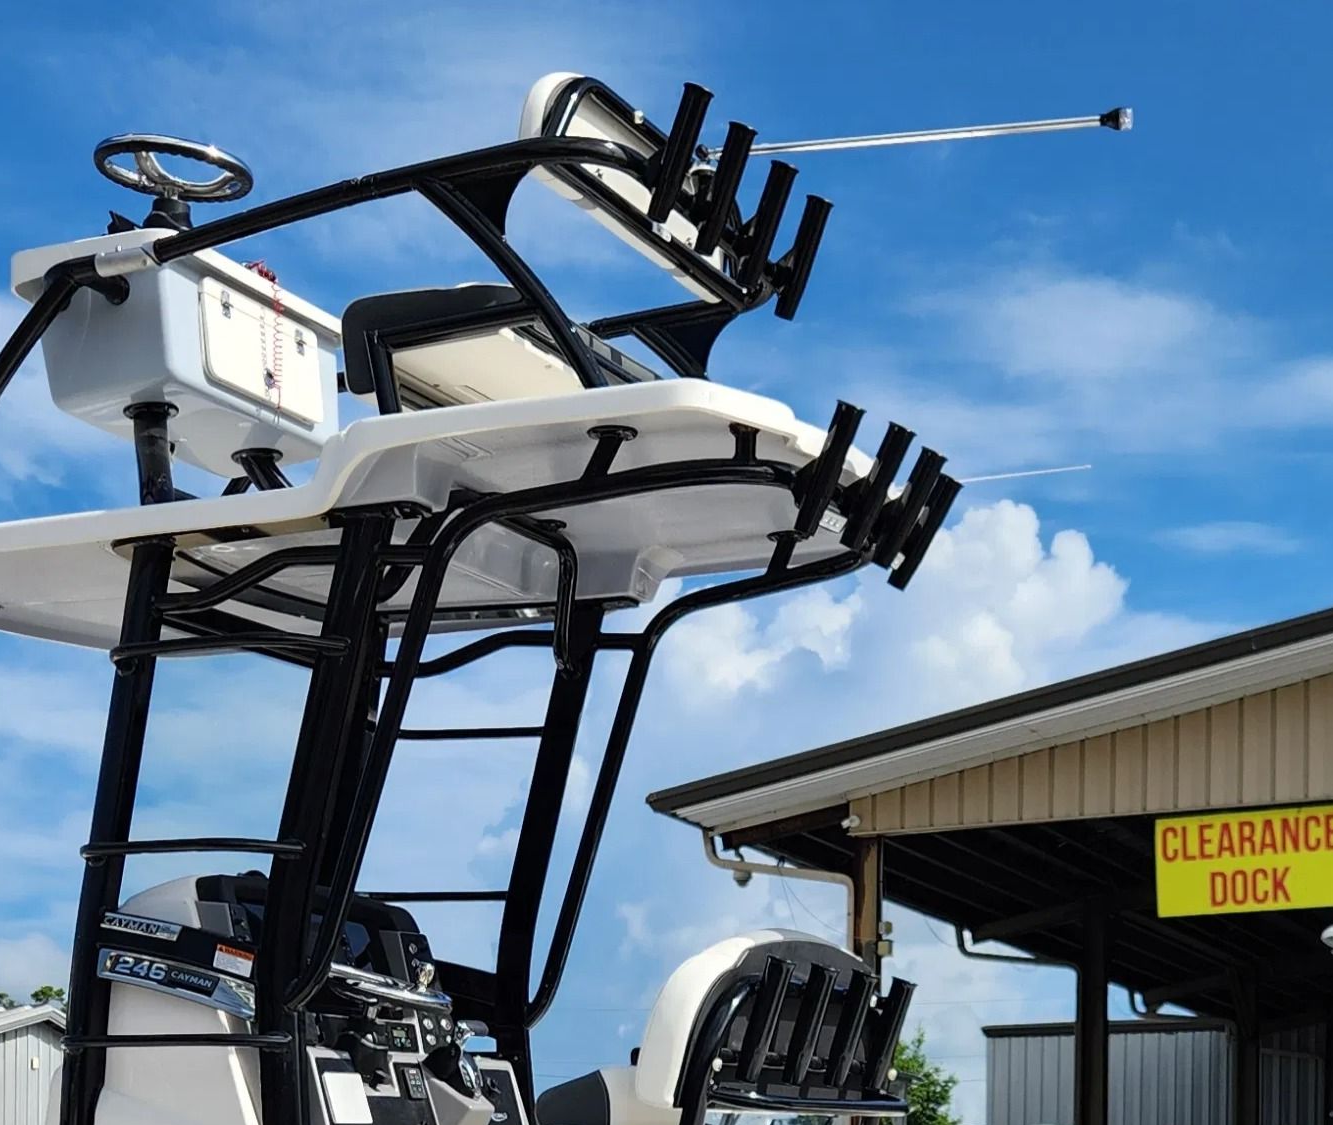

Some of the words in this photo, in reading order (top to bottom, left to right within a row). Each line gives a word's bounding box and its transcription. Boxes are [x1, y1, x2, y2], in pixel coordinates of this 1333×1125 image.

[1210, 867, 1291, 907] DOCK
[103, 916, 158, 935] CAYMAN
[115, 956, 168, 980] 246
[170, 971, 213, 988] CAYMAN
